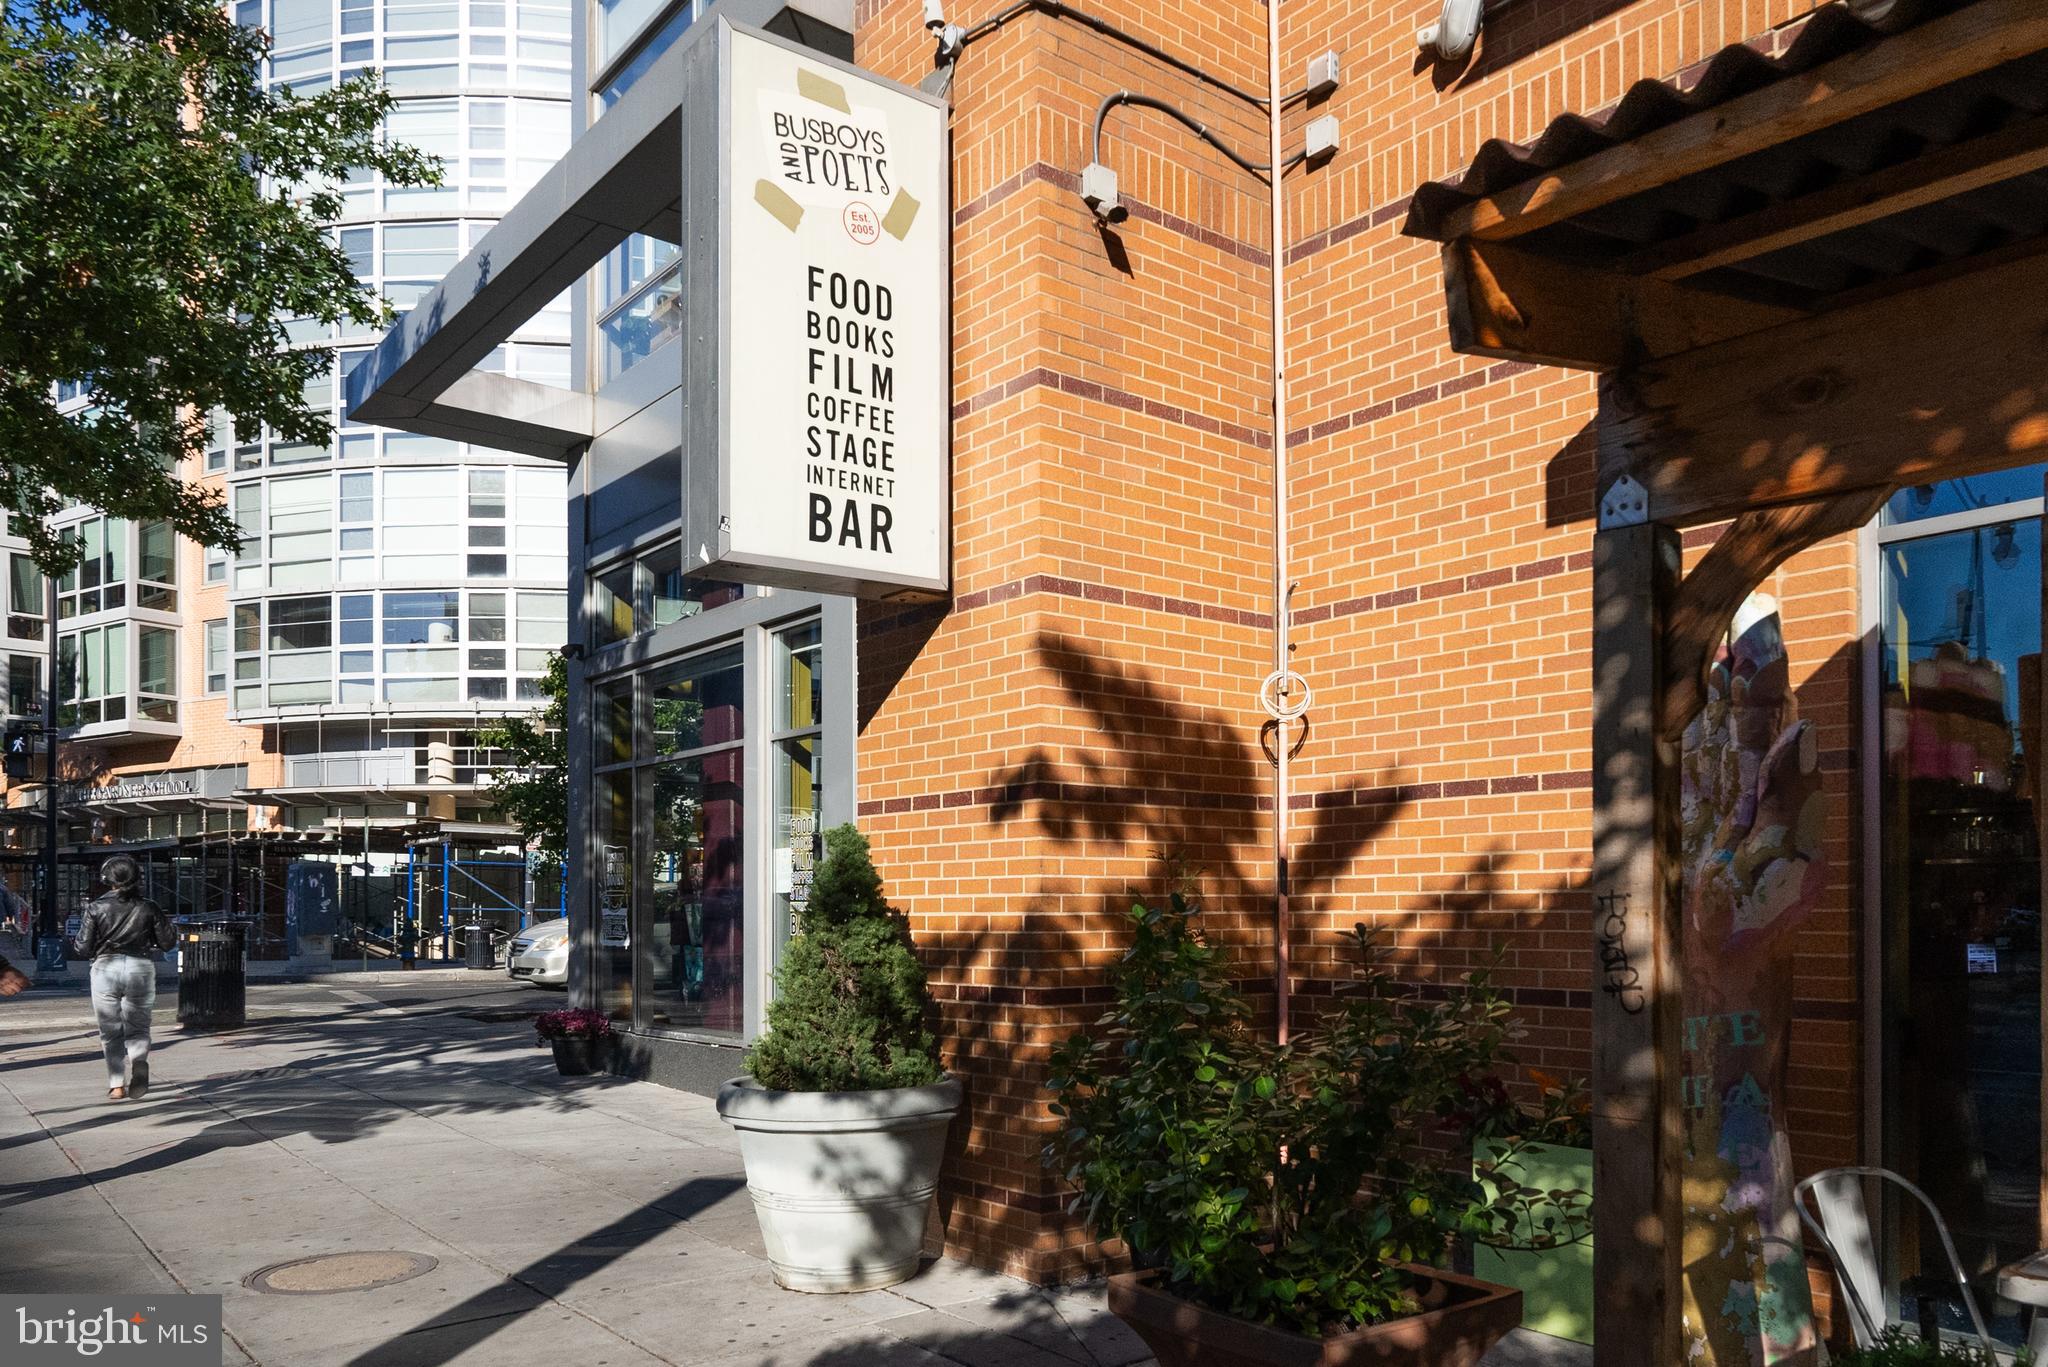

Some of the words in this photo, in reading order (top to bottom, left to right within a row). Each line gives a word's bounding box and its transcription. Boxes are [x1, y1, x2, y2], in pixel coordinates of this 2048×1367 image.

[774, 112, 885, 155] BUSBOYS
[780, 142, 803, 182] AND
[801, 145, 890, 196] POETS
[851, 211, 871, 223] Est.
[851, 223, 875, 236] 2005
[808, 265, 892, 321] FOOD
[807, 310, 894, 358] BOOKS
[809, 348, 893, 403] FILM
[807, 392, 895, 435] COFFEE
[807, 425, 895, 472] STAGE
[807, 464, 895, 498] INTERNET
[809, 492, 893, 554] BAR
[790, 836, 813, 851] BOOKS
[791, 817, 813, 836] FOOD
[790, 852, 813, 870] FILM
